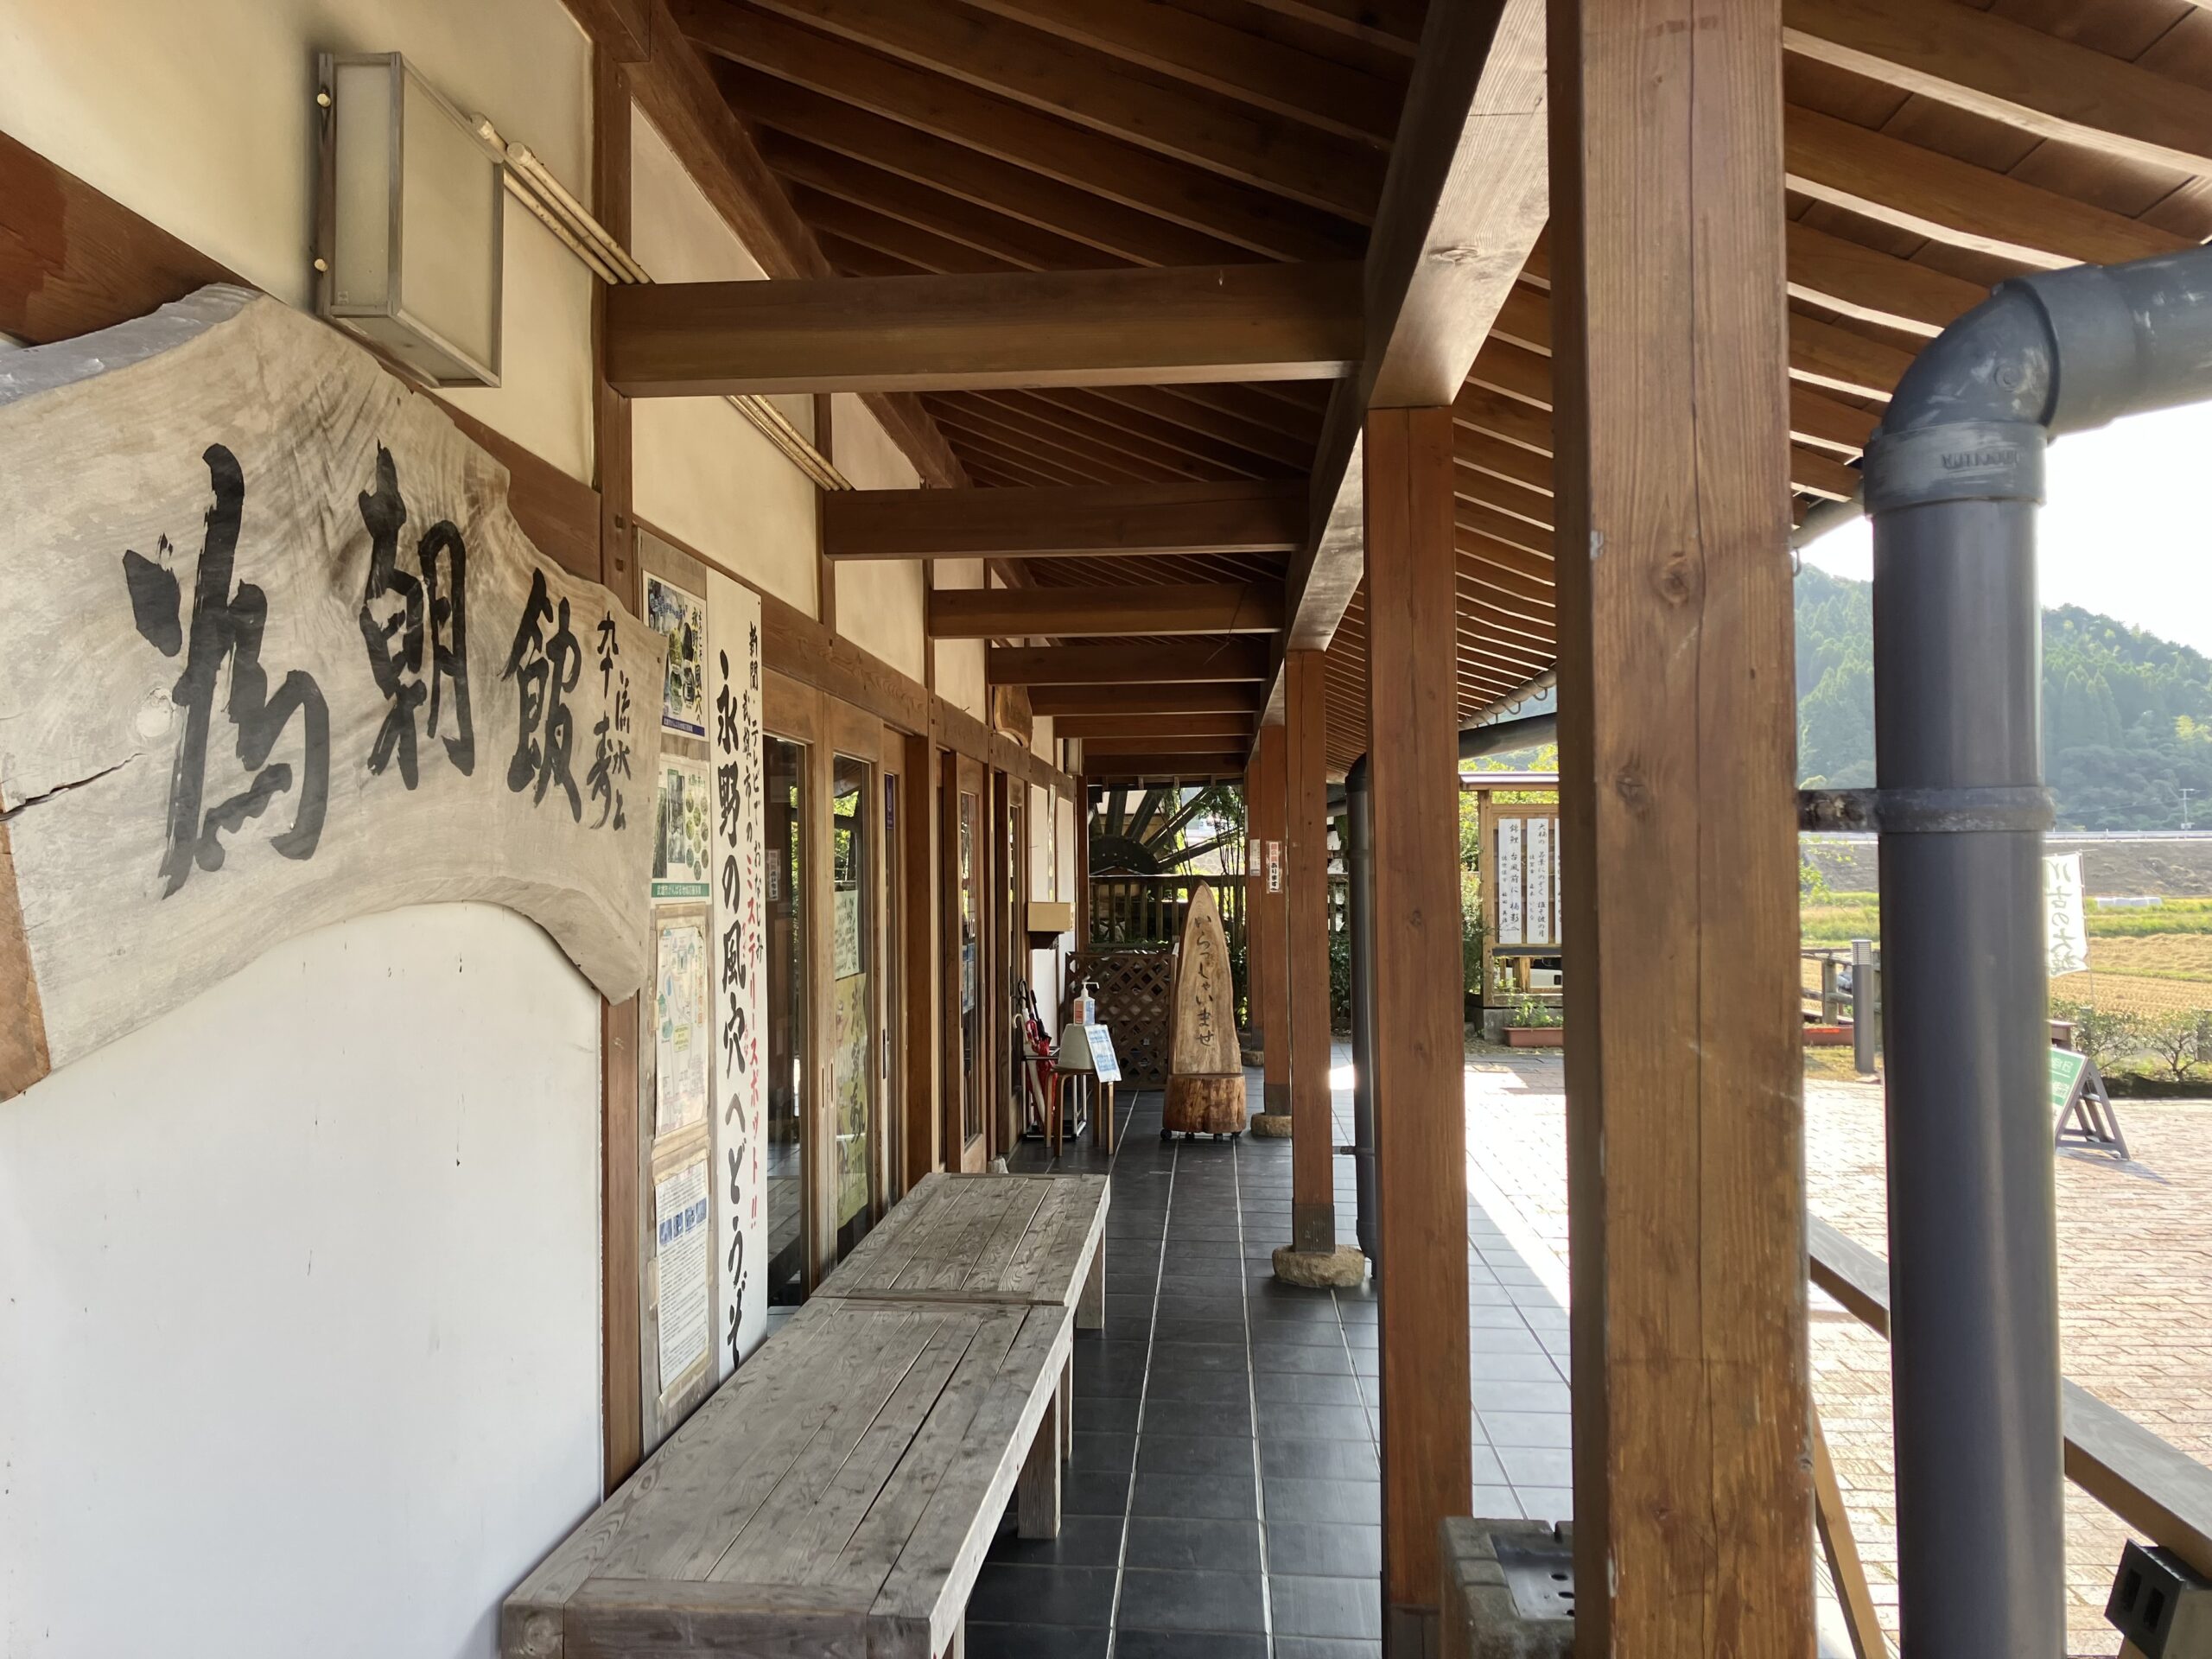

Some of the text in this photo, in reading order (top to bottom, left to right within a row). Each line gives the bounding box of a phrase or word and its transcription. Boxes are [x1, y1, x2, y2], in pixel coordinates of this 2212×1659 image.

[1194, 915, 1215, 1047] いらっしゃいませ
